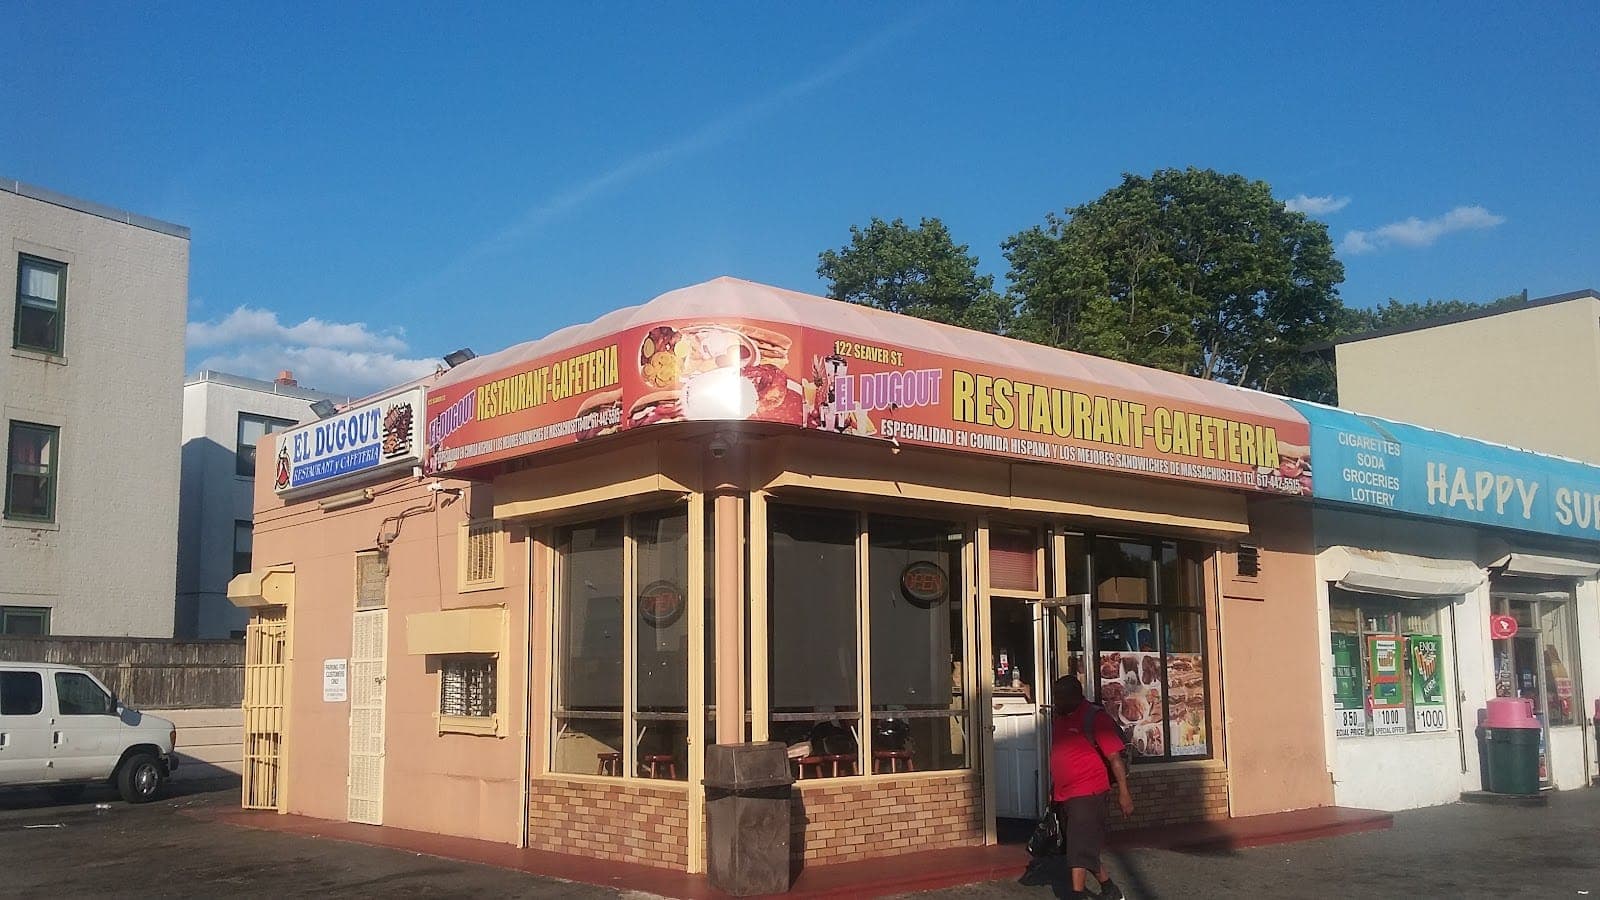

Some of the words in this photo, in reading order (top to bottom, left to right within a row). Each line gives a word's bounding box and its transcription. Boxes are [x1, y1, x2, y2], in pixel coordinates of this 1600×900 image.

[834, 340, 852, 357] 122
[854, 343, 889, 364] SEAVER
[476, 344, 619, 422] RESTAURANT-CAFETERIA
[835, 375, 856, 412] EL
[860, 368, 942, 411] DUGOUT
[294, 431, 311, 463] EL
[315, 407, 381, 456] DUGOUT
[440, 390, 475, 441] DUGOUT
[953, 370, 1280, 469] RESTAURANT-CAFETERIA
[293, 460, 334, 481] RESTAURANT
[341, 447, 379, 469] CAFETERIA
[881, 419, 953, 445] ESPECIALIDAD
[956, 431, 968, 447] EN
[970, 432, 1009, 452] COMIDA
[1011, 438, 1051, 458] HISPANA
[1052, 444, 1058, 459] Y
[1060, 445, 1076, 461] LOS
[1077, 447, 1115, 467] MEJORES
[1116, 453, 1169, 474] SANDWICHES
[1170, 461, 1180, 475] DE
[1181, 462, 1242, 483] MASSACHUSETTS
[1338, 431, 1401, 457] CIGARETTES
[1357, 453, 1385, 471] SODA
[1343, 468, 1400, 491] GROCERIES
[1351, 487, 1395, 507] LOTTERY
[1426, 461, 1539, 520] HAPPY
